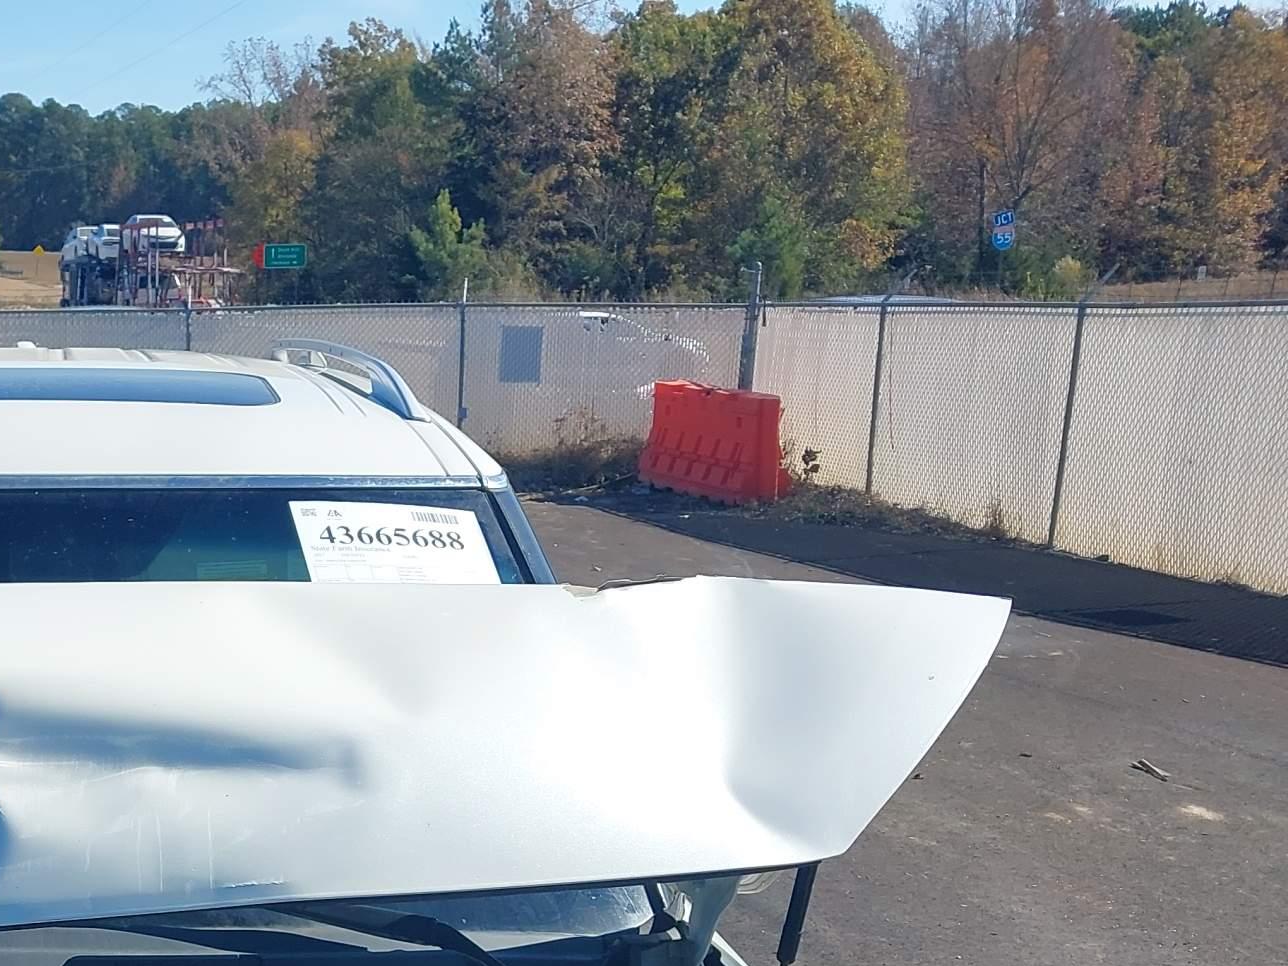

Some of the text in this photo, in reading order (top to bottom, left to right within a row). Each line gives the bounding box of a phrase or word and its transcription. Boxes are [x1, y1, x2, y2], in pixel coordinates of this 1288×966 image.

[995, 212, 1012, 226] JCT
[996, 232, 1011, 244] 55
[319, 524, 465, 551] 43665688
